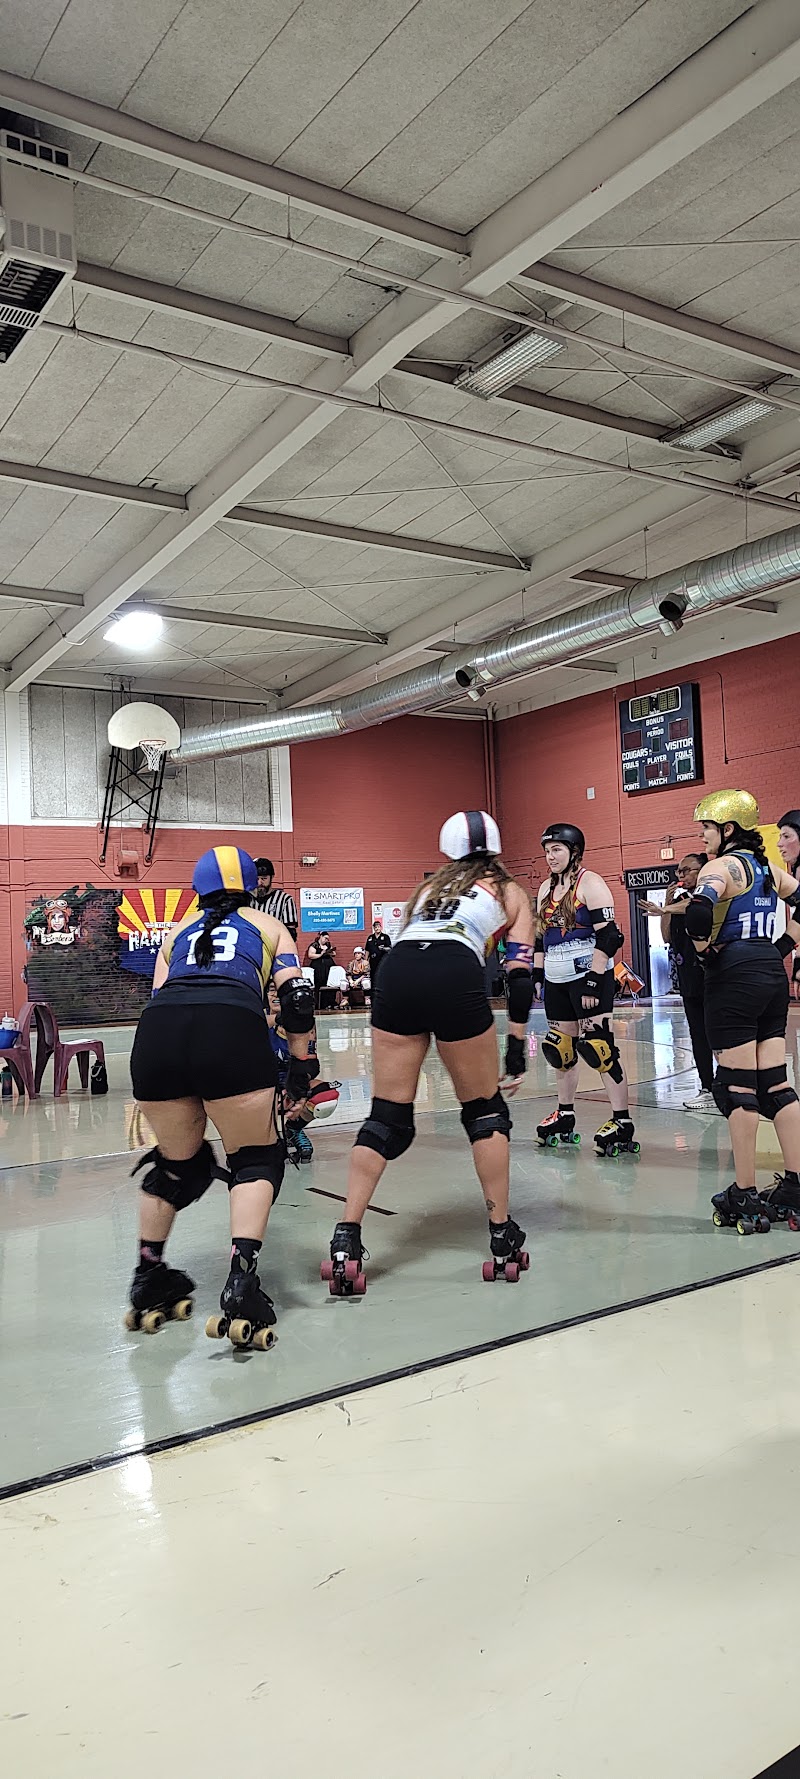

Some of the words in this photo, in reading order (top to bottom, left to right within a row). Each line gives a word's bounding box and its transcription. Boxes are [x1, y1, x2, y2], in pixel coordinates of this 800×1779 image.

[646, 716, 664, 726] BONUS
[647, 728, 664, 737] PERIOD
[665, 737, 693, 751] VISITOR
[622, 748, 648, 761] COUGARS
[647, 754, 667, 764] PLAYER
[675, 749, 693, 760] FOULS
[623, 761, 639, 769] FOULS
[677, 772, 694, 781] POINTS
[624, 783, 640, 791] POINTS
[648, 777, 667, 787] MATCH
[628, 870, 669, 887] RESTROOMS
[313, 892, 360, 900] SMARTPRO
